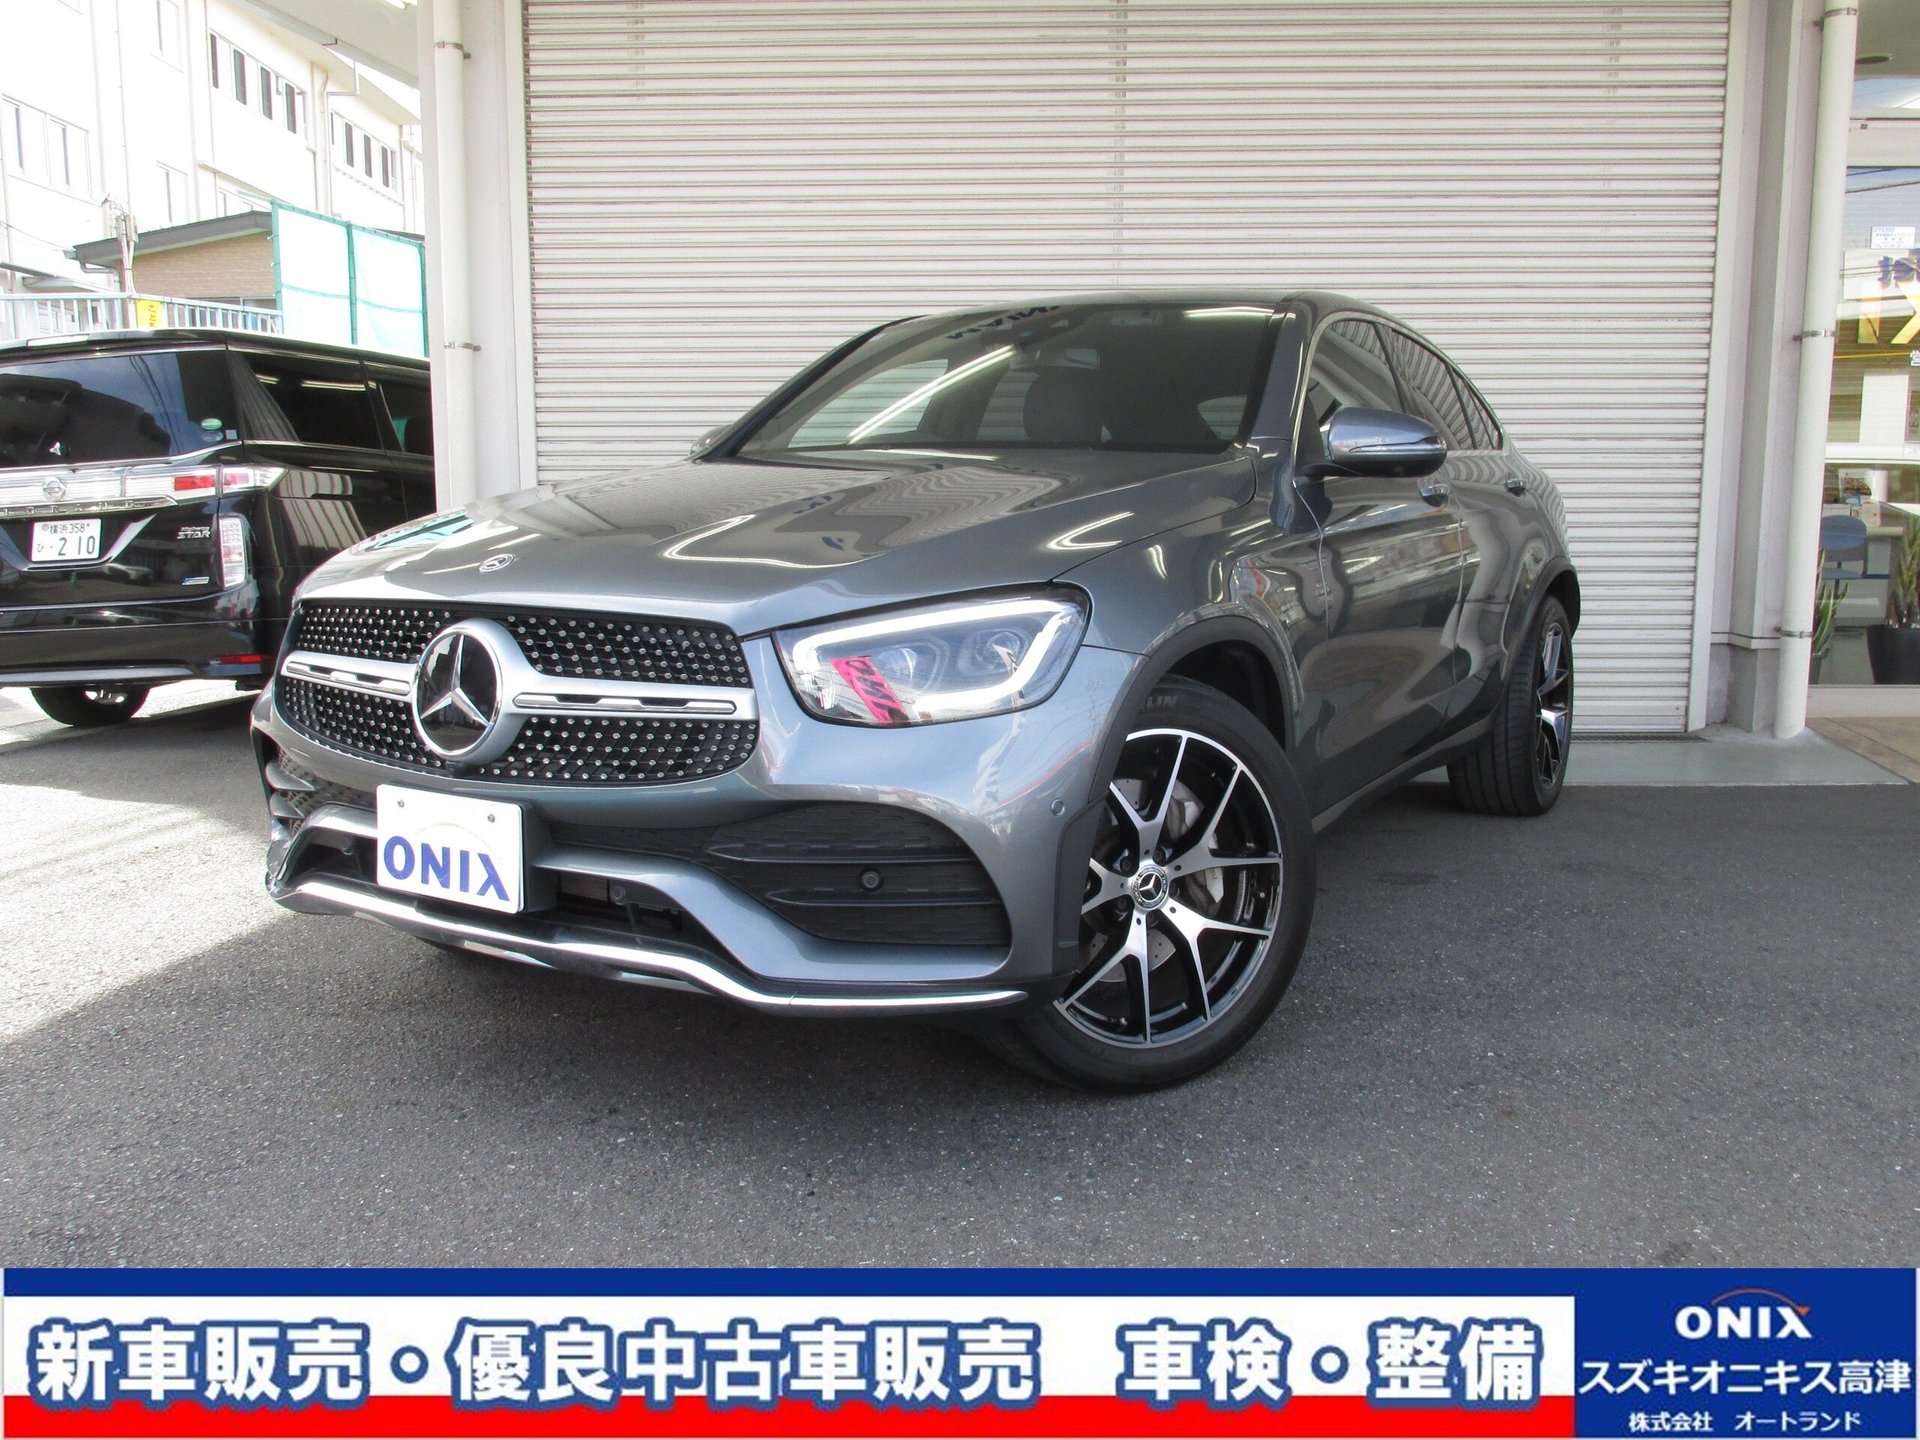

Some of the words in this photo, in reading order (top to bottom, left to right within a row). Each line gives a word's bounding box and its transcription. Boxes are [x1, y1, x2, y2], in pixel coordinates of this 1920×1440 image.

[69, 523, 85, 533] 358
[177, 531, 210, 539] STAR
[383, 835, 510, 902] ONIX
